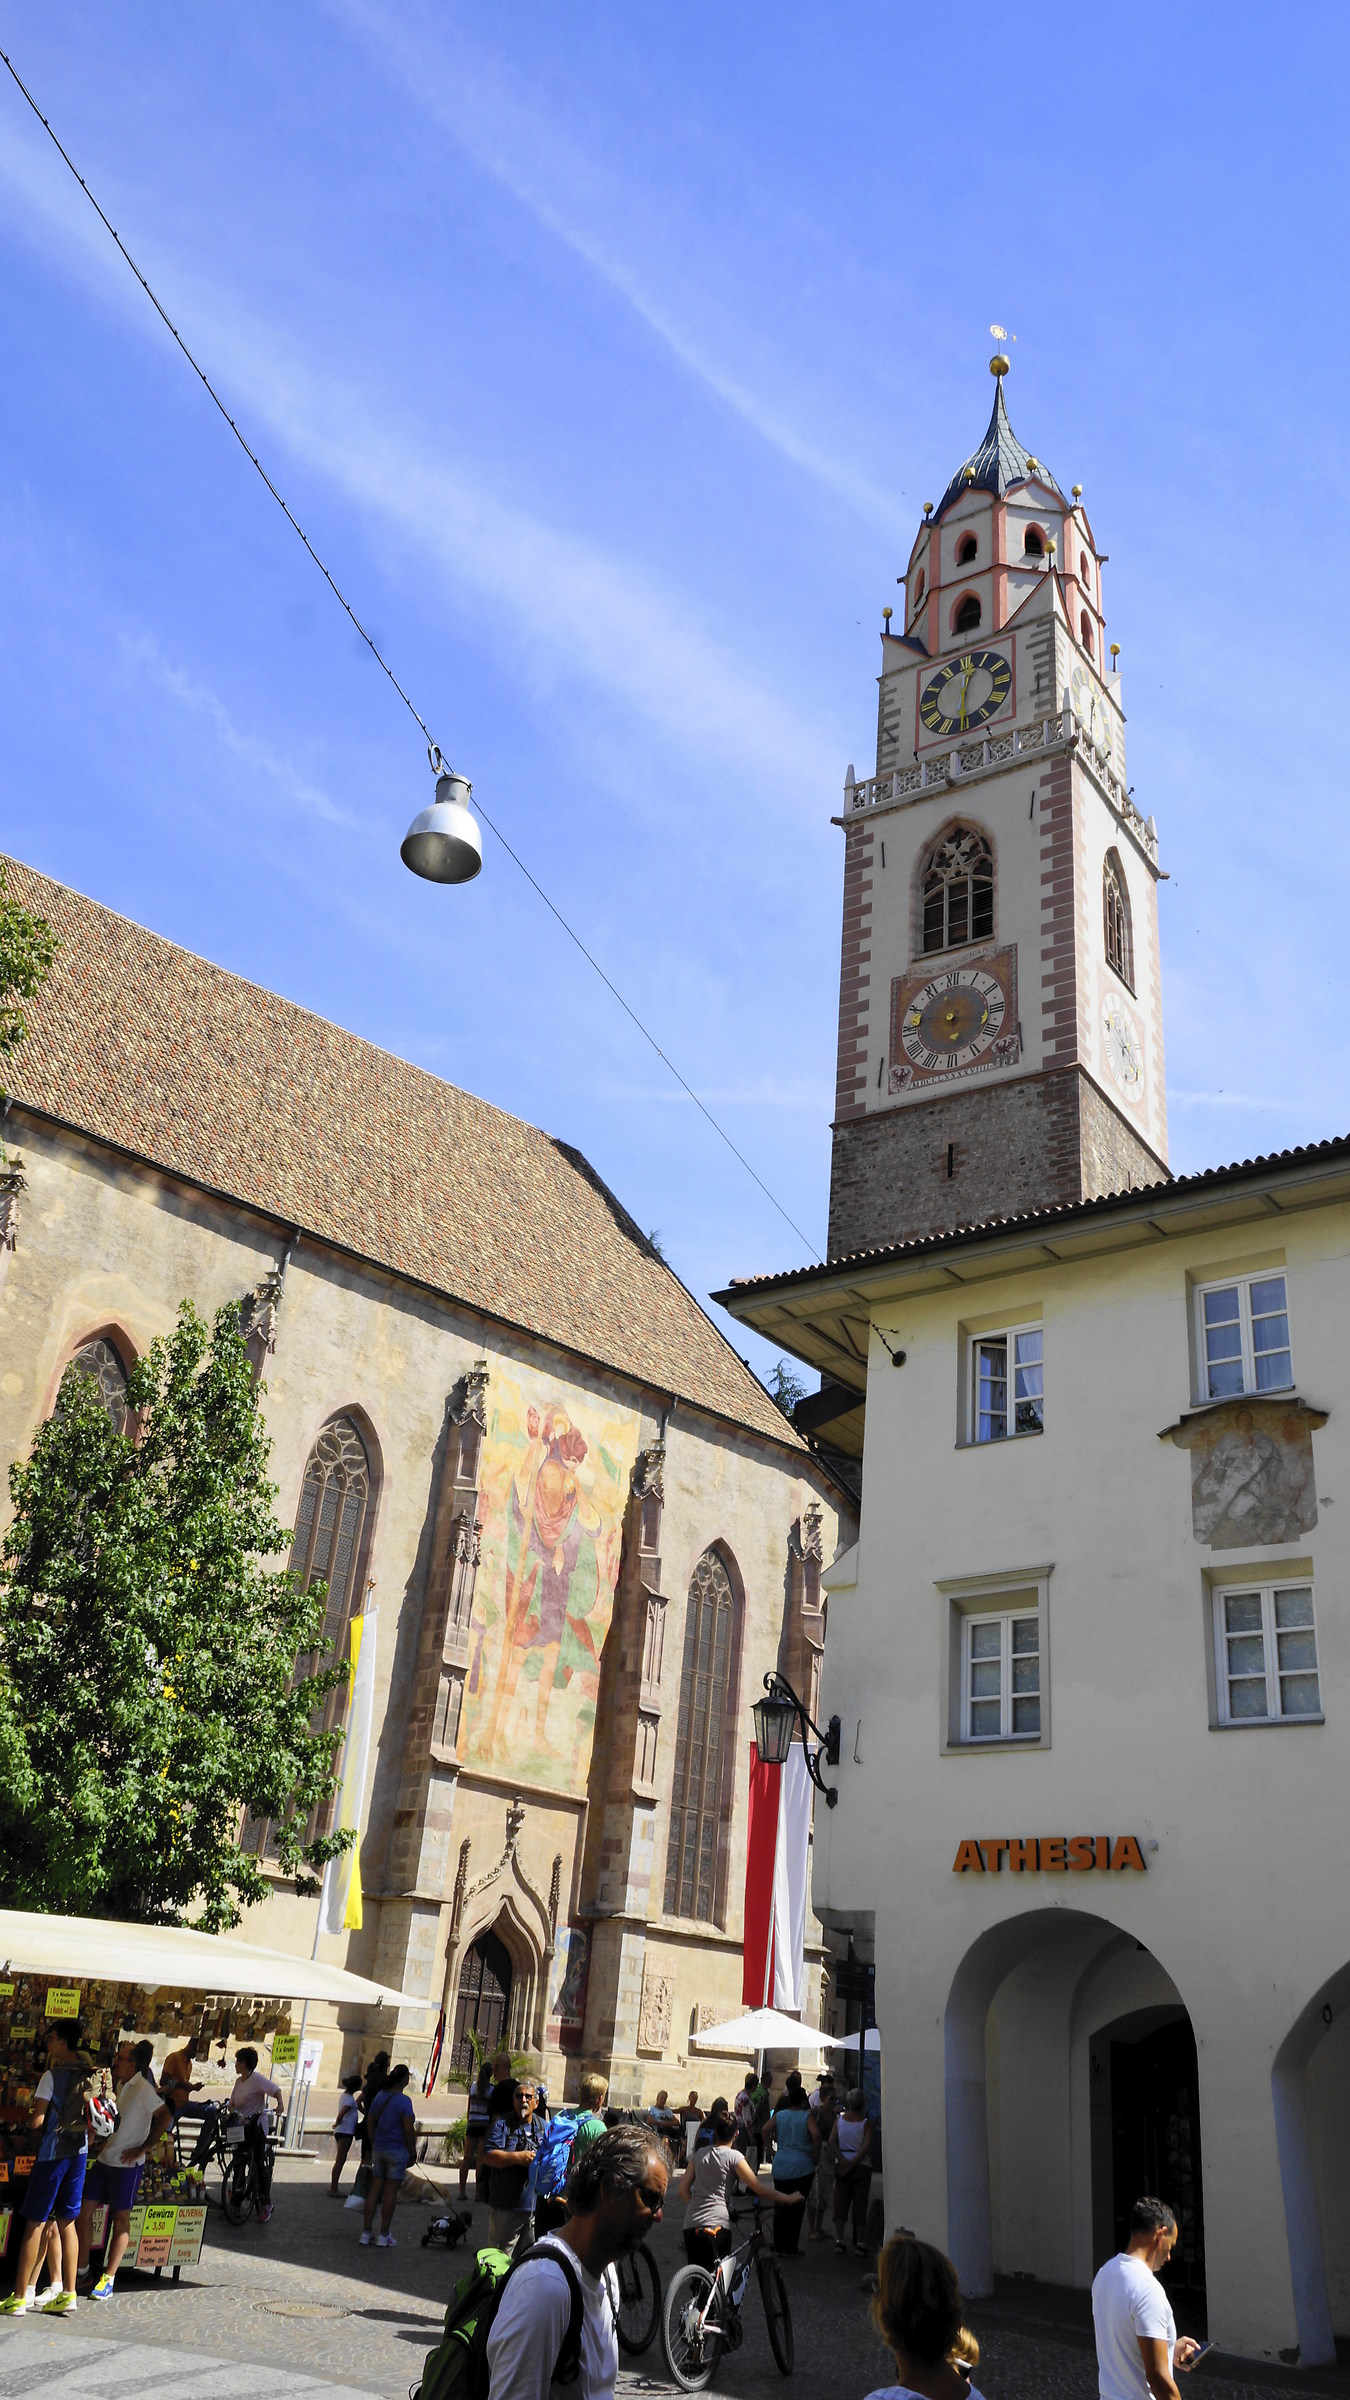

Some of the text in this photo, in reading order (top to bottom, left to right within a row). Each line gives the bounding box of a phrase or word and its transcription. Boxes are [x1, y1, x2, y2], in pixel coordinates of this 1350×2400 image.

[989, 659, 1005, 673] II
[994, 673, 1010, 685] III
[946, 972, 960, 988] XII
[970, 972, 979, 986] I
[924, 983, 938, 1000] XI
[983, 982, 999, 996] II
[989, 1001, 1005, 1014] III
[982, 1023, 1000, 1037] IIII
[906, 1040, 924, 1060] VIII
[922, 1053, 938, 1069] VII
[946, 1053, 958, 1068] VI
[952, 1836, 1146, 1872] ATHESIA
[148, 2208, 174, 2218] Gewürze
[152, 2222, 166, 2231] 3,50
[177, 2249, 192, 2258] Essig
